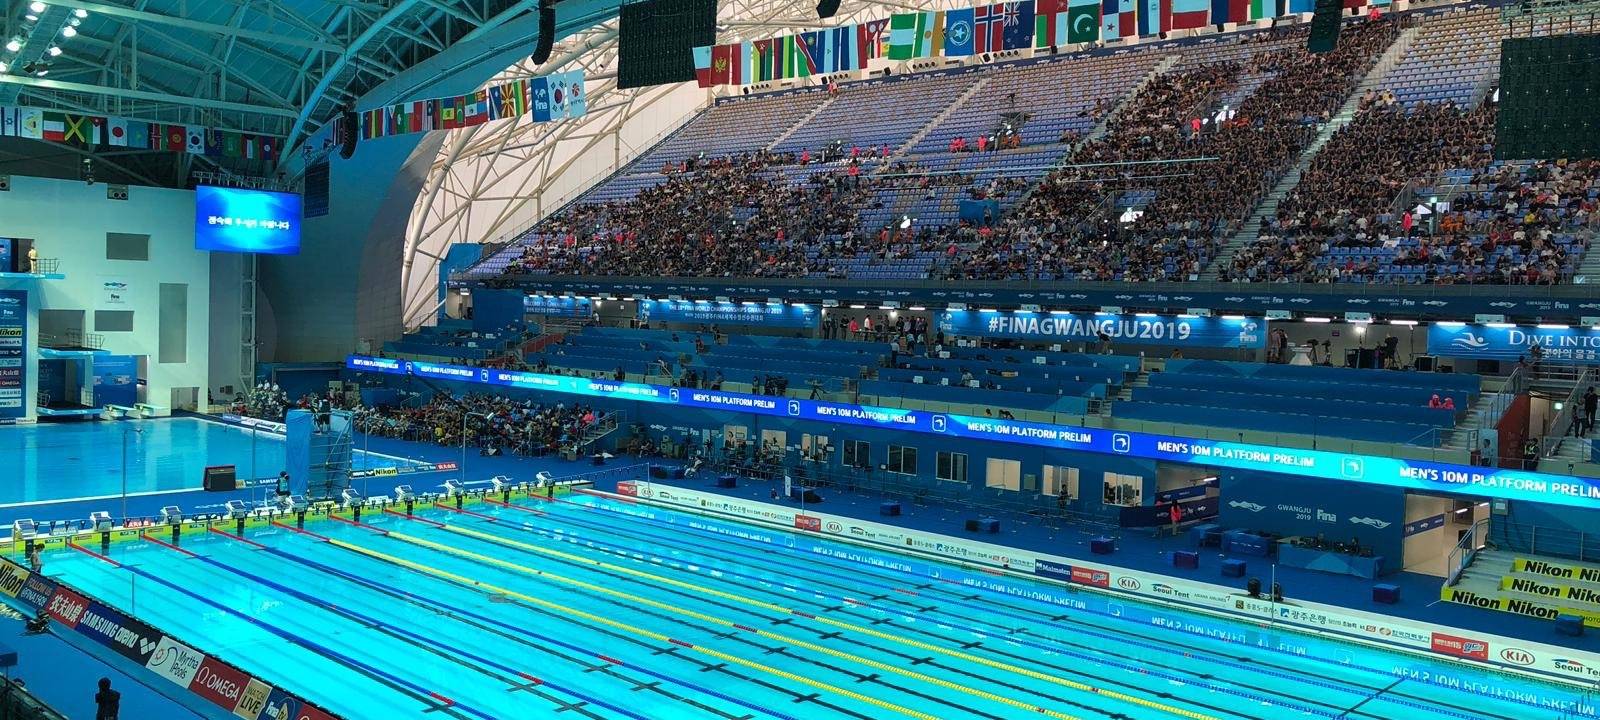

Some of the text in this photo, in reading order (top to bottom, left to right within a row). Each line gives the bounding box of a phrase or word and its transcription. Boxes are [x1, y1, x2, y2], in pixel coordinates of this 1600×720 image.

[988, 316, 1191, 340] #FINAGWANGJU2019
[693, 394, 775, 409] MEN'S 10M PLATFORM PRELIM
[817, 406, 916, 424] MEN'S 10M PLATFORM PRELIM
[968, 422, 1091, 443] MEN'S 10M PLATFORM PRELIM
[1158, 441, 1314, 467] MEN'S 10M PLATFORM PRELIM
[1400, 466, 1438, 480] MEN'S
[1442, 471, 1468, 484] 10M
[1472, 474, 1546, 493] PLATFORM
[1278, 504, 1311, 514] GWANGJU
[944, 545, 967, 556] 광주은행
[1524, 561, 1573, 578] Nikon
[0, 564, 24, 594] Nikon
[1121, 579, 1137, 588] KIA
[1153, 586, 1189, 598] Seoul Tent
[1512, 579, 1560, 597] Nikon
[1452, 591, 1558, 618] Nikon Nikon
[80, 610, 119, 638] SAMSUNG
[1291, 610, 1326, 624] 광주은행
[115, 627, 139, 648] arena
[178, 652, 199, 669] Myrtha
[1506, 651, 1529, 663] KIA
[170, 662, 187, 679] Pools
[1555, 662, 1600, 675] Seoul Te
[207, 674, 240, 701] OMEGA
[247, 687, 265, 700] WATCH
[240, 695, 261, 715] LIVE
